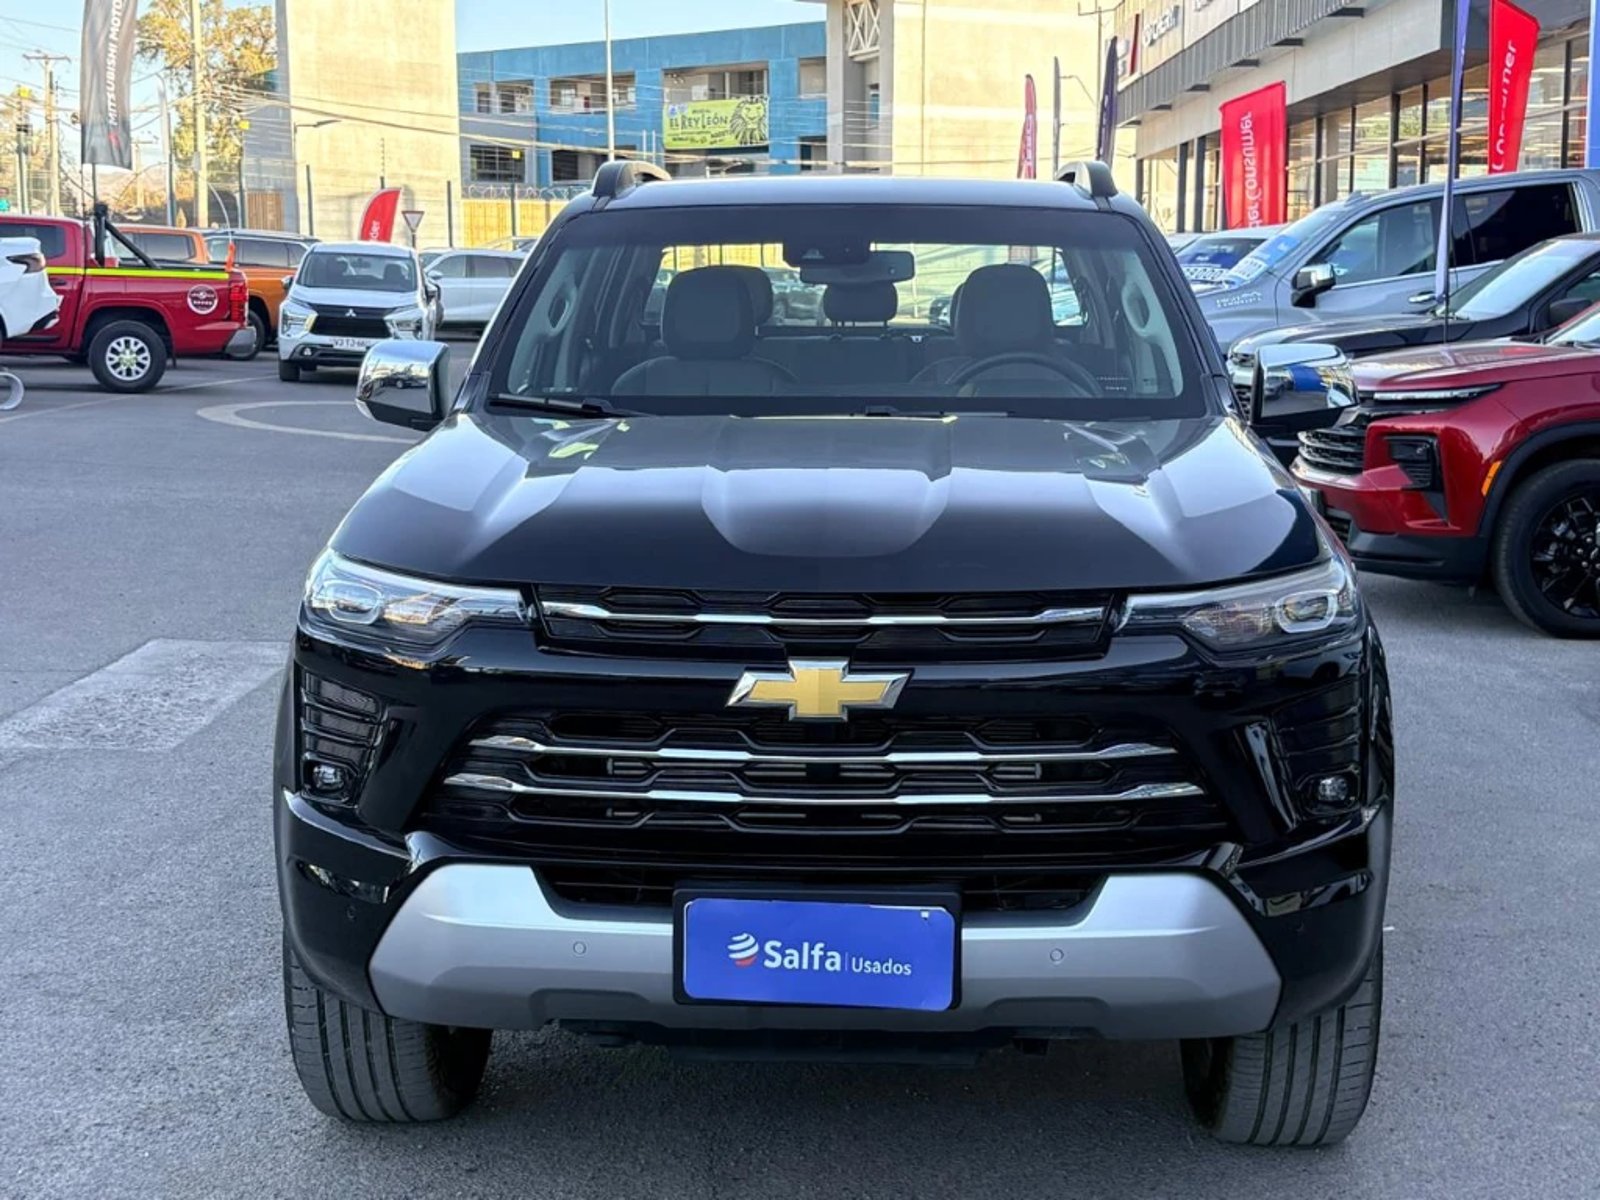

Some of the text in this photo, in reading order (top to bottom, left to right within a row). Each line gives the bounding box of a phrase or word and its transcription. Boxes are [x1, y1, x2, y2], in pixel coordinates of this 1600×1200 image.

[106, 43, 118, 127] MITSUBISHI
[763, 940, 913, 977] Salfa Usados
